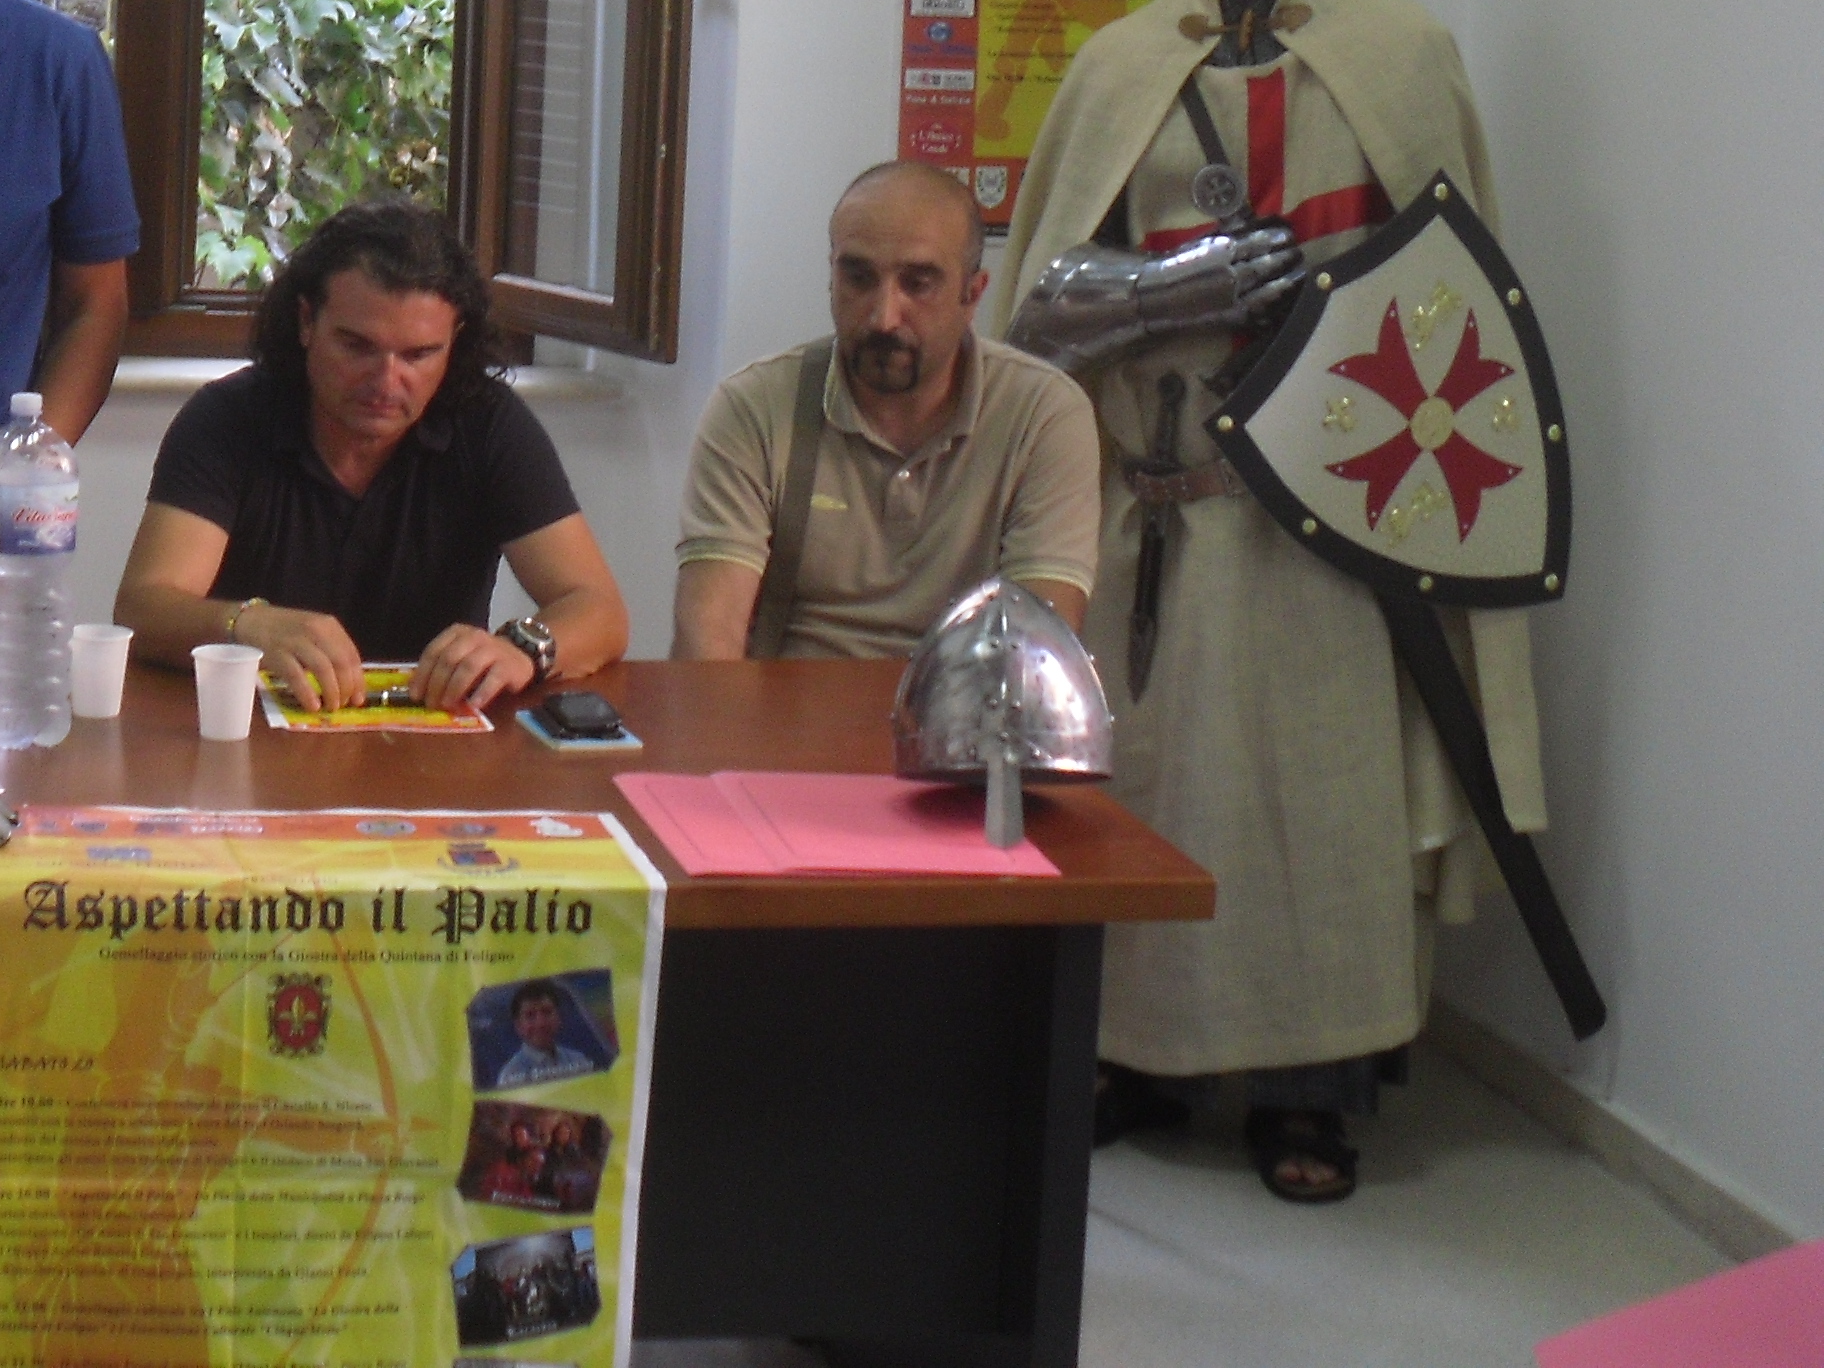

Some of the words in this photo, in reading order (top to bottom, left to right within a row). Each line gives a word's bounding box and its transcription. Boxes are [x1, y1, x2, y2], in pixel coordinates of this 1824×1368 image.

[23, 878, 345, 940] Aspettando
[371, 886, 409, 934] il
[431, 885, 593, 945] Palio
[98, 945, 189, 963] Gemellaggio
[191, 946, 238, 961] storico
[241, 949, 268, 962] con
[271, 947, 285, 962] la
[288, 947, 338, 963] Giostra
[342, 948, 376, 963] della
[380, 949, 442, 964] Quintana
[445, 949, 459, 963] di
[464, 949, 515, 966] Foligno
